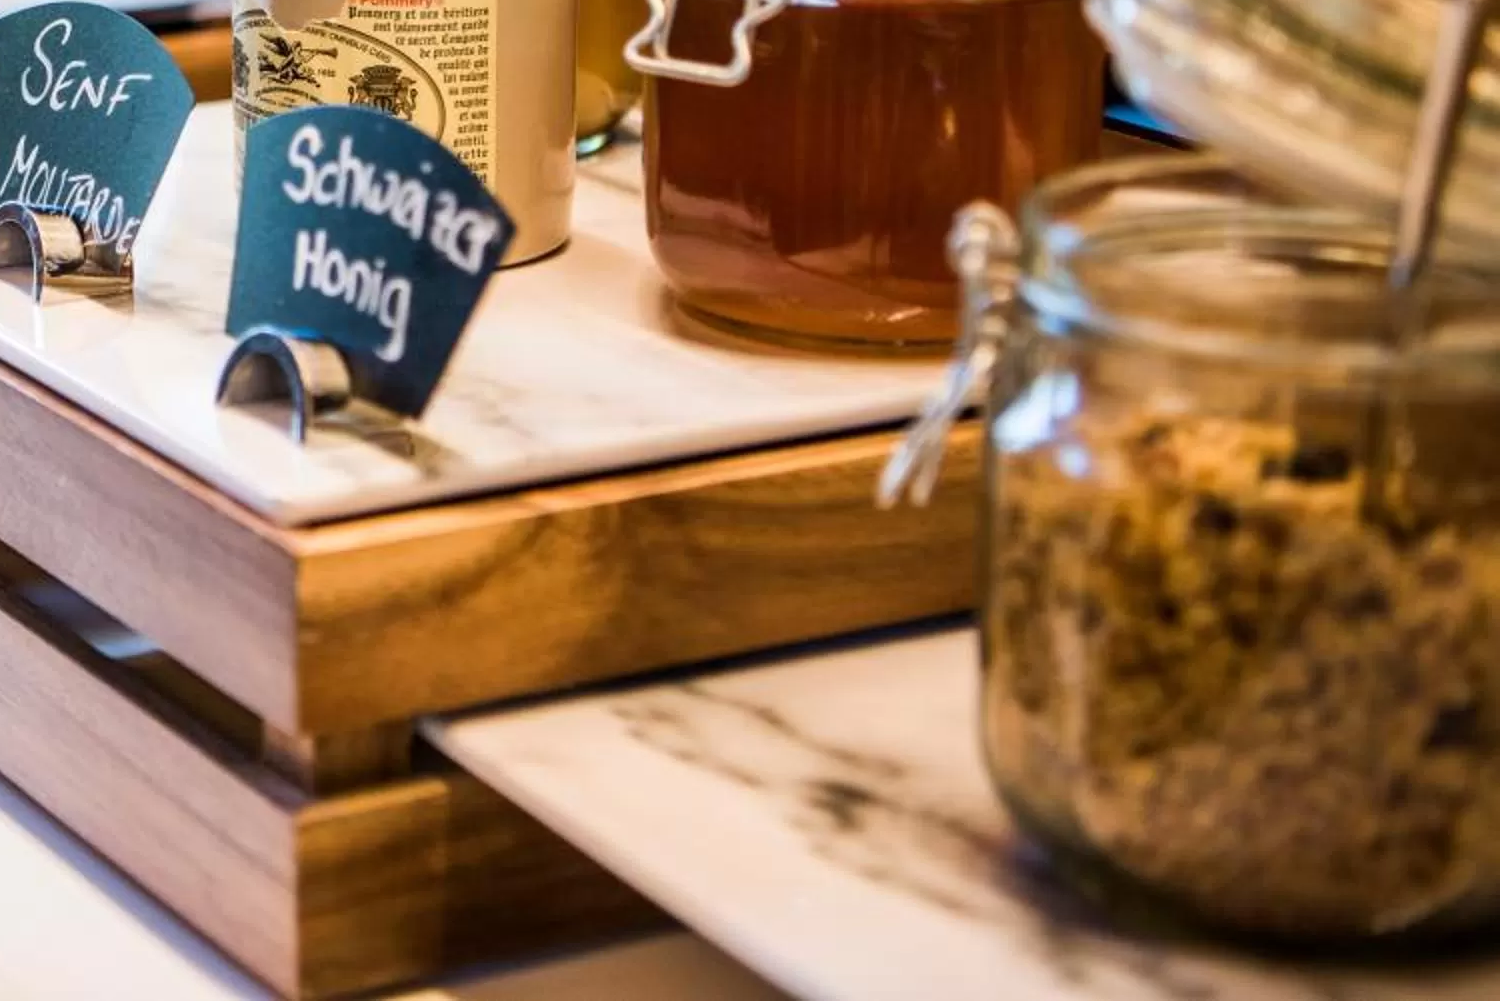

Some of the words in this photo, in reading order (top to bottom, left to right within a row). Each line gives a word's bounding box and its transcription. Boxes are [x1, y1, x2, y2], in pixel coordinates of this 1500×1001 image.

[348, 6, 400, 20] Pommery
[405, 8, 417, 19] et
[293, 228, 412, 362] Honig
